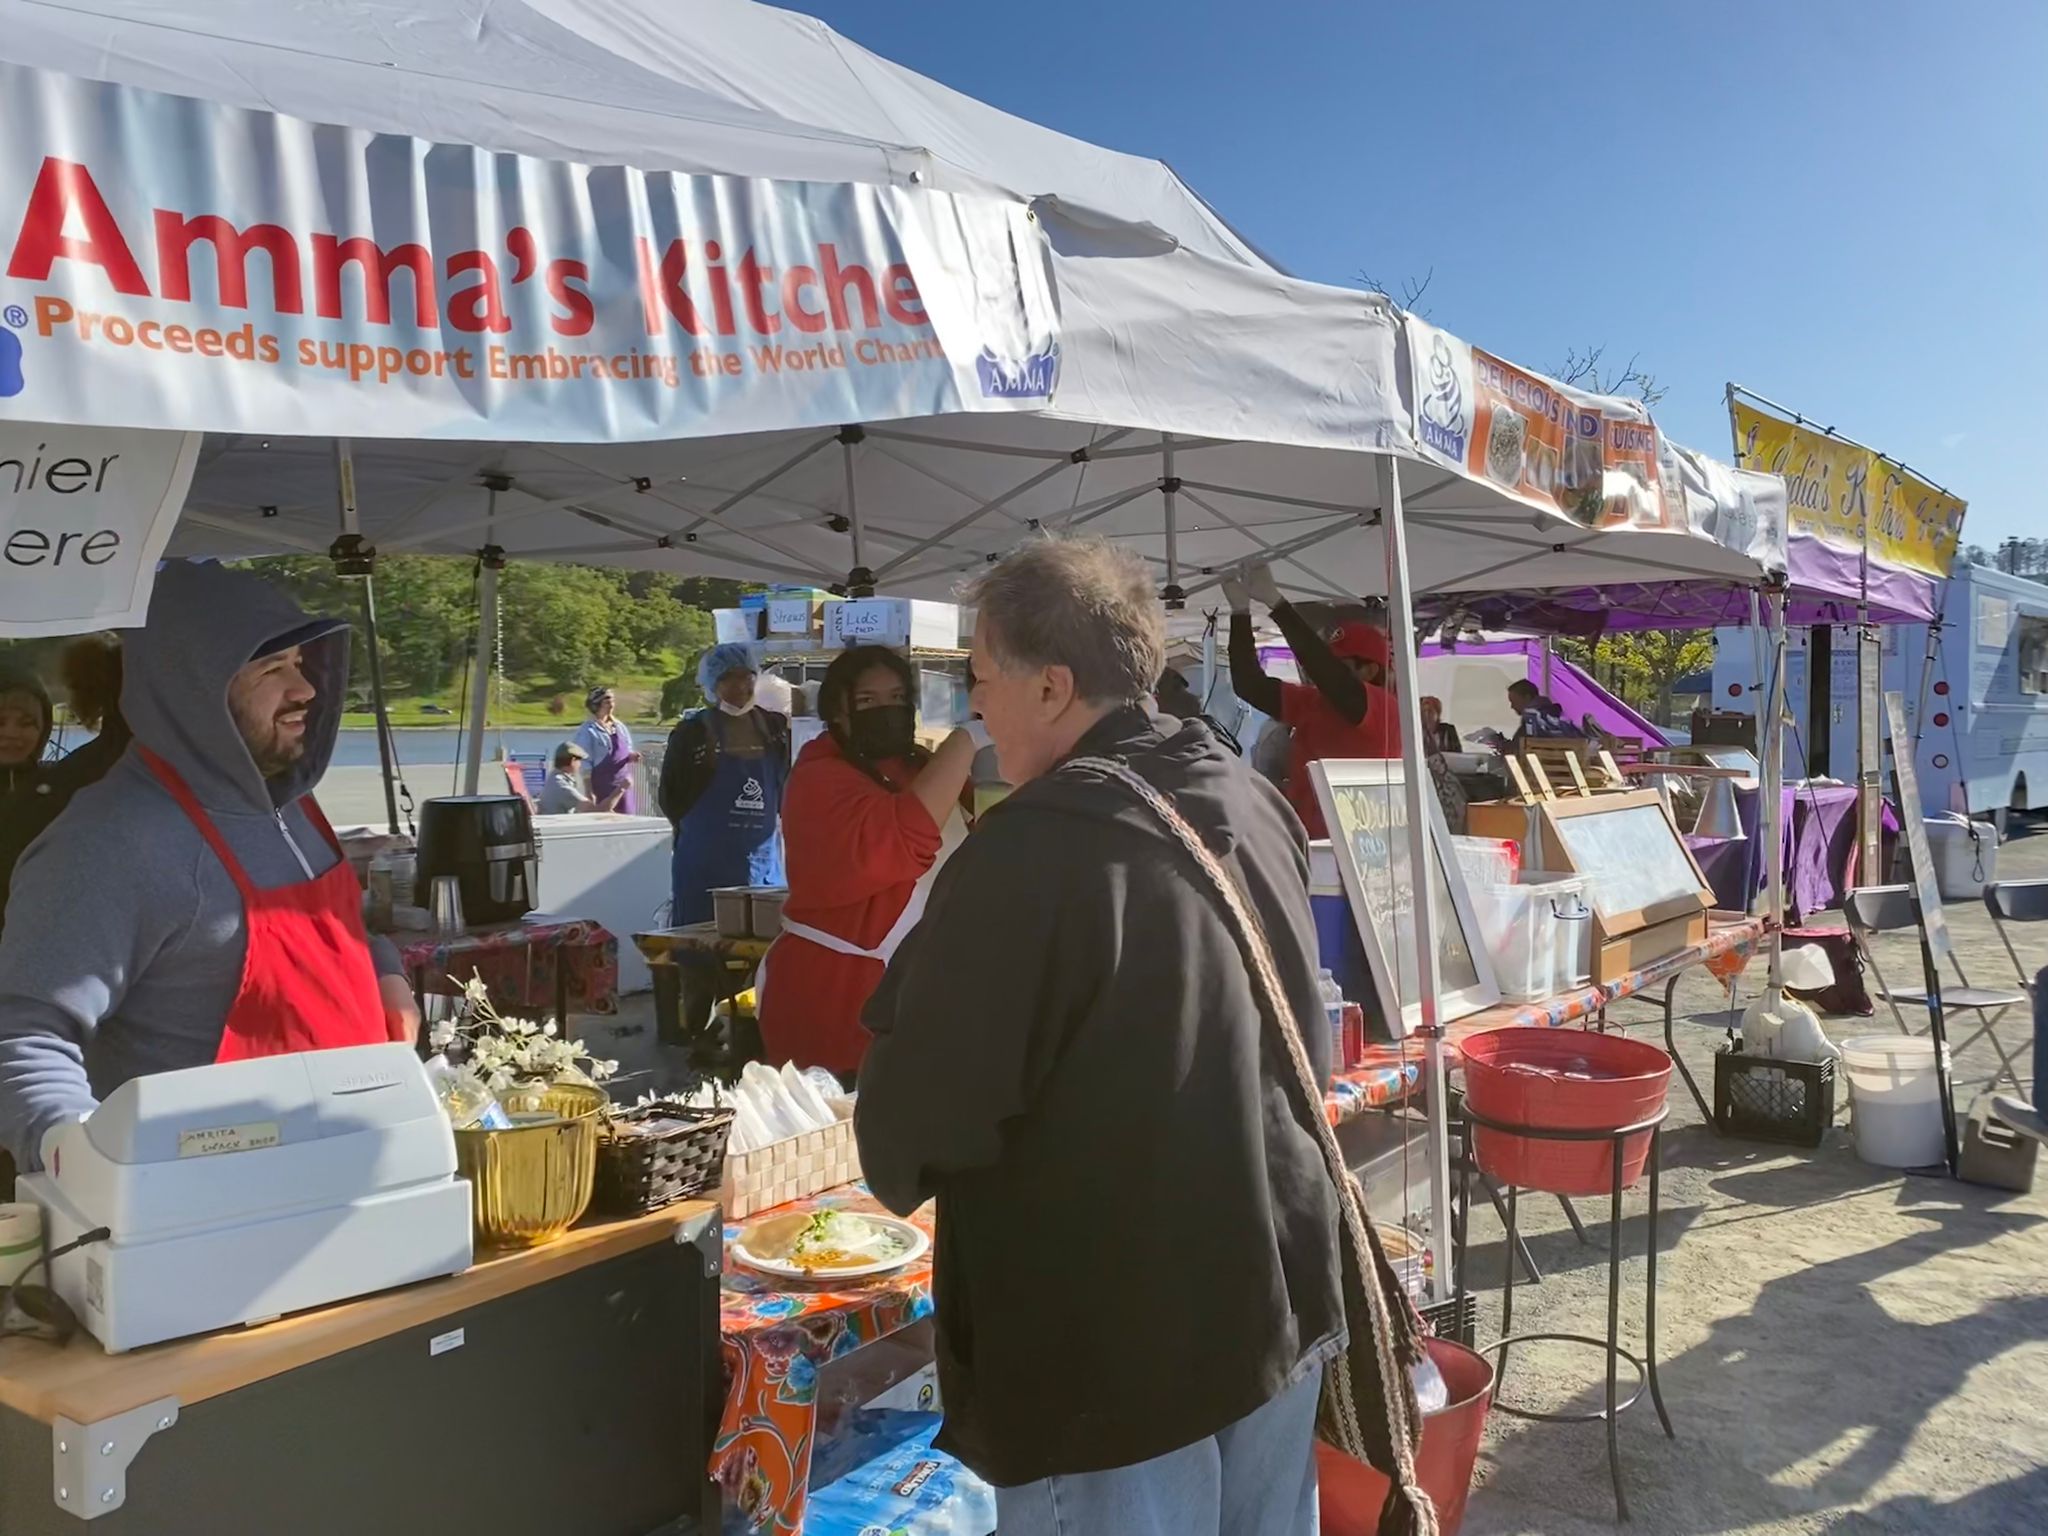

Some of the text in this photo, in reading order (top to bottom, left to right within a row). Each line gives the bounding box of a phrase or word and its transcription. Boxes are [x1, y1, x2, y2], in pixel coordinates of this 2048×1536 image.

[6, 155, 594, 337] Amma's
[34, 296, 280, 363] Proceeds
[298, 337, 473, 383] support
[489, 346, 680, 388] Embracing
[690, 344, 741, 376] the
[751, 341, 845, 373] World
[1476, 356, 1559, 423] DELICIOUS
[1426, 427, 1458, 459] AMMA
[846, 611, 878, 626] Lids
